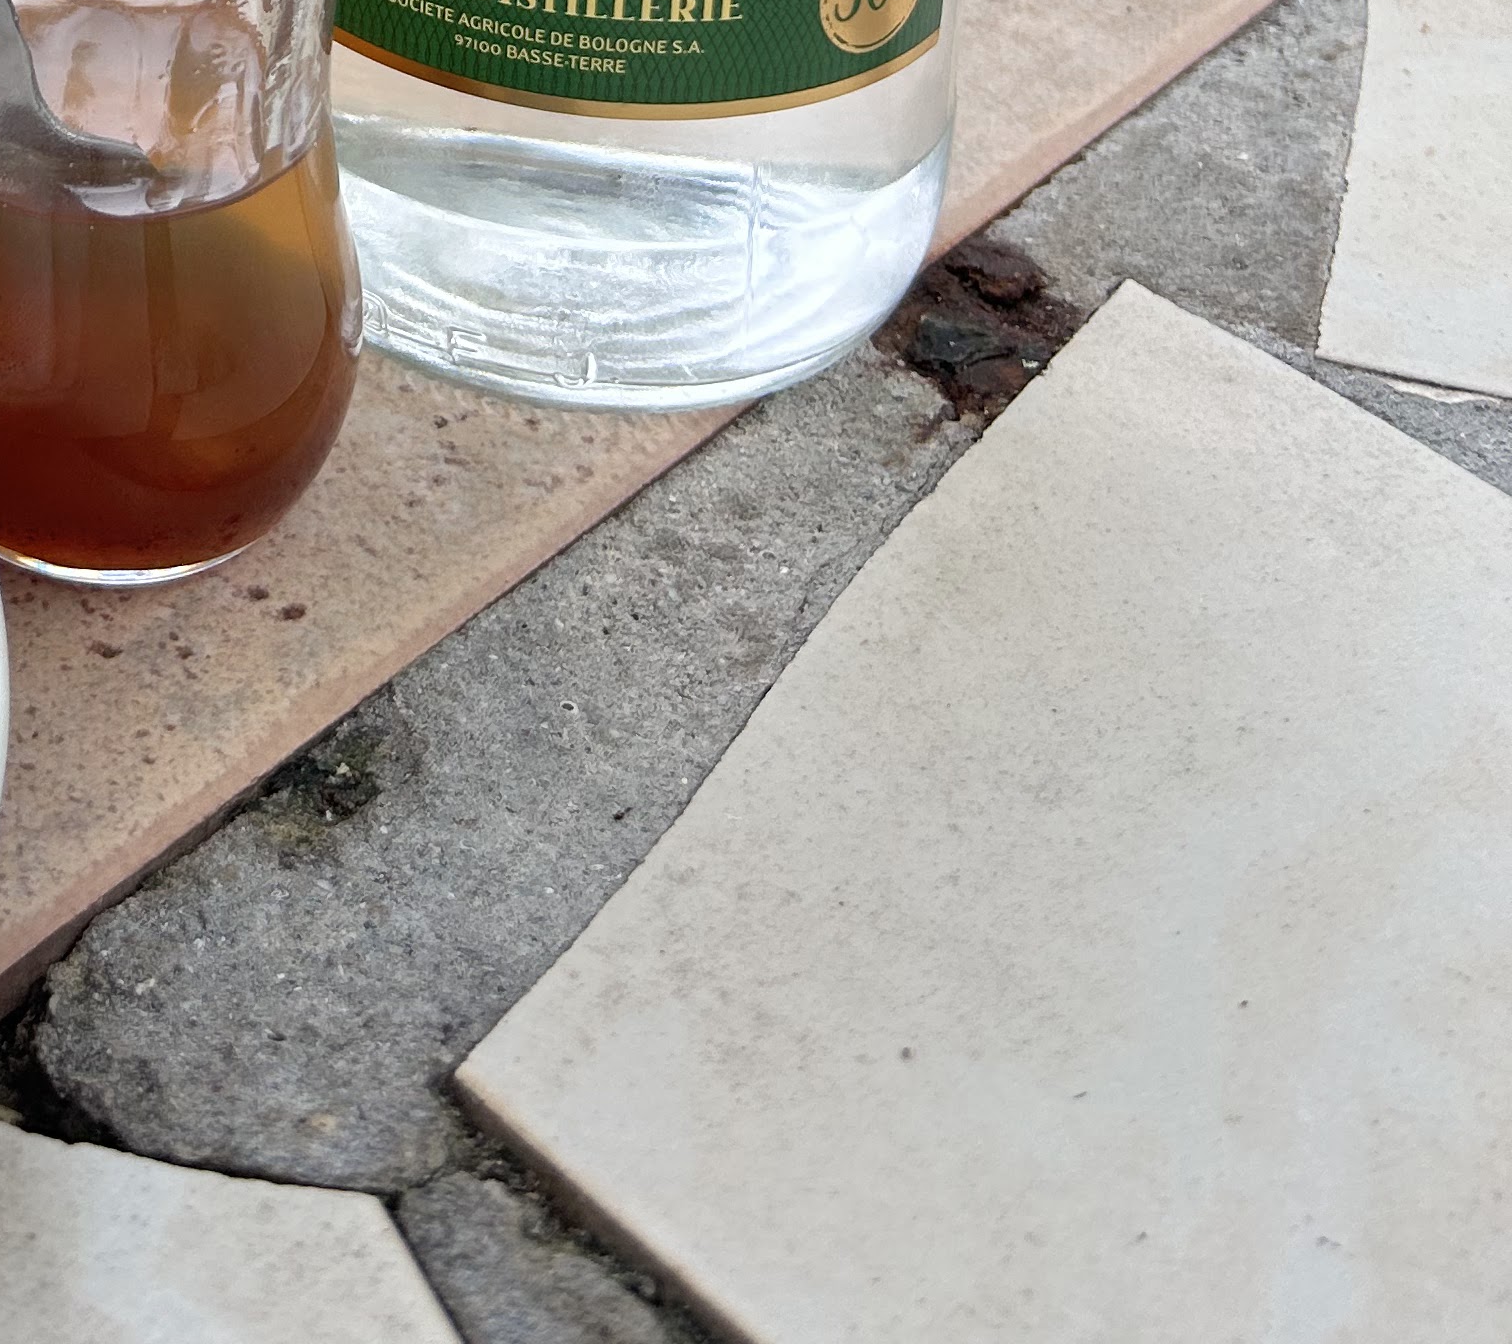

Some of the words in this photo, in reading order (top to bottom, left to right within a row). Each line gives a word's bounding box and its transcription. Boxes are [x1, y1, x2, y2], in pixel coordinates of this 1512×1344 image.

[454, 33, 502, 56] 97100
[506, 44, 627, 74] BASSE-TERRE
[458, 12, 546, 44] AGRICOLE
[550, 31, 574, 48] DE
[578, 34, 667, 54] BOLOGNE
[672, 39, 705, 55] S.A.
